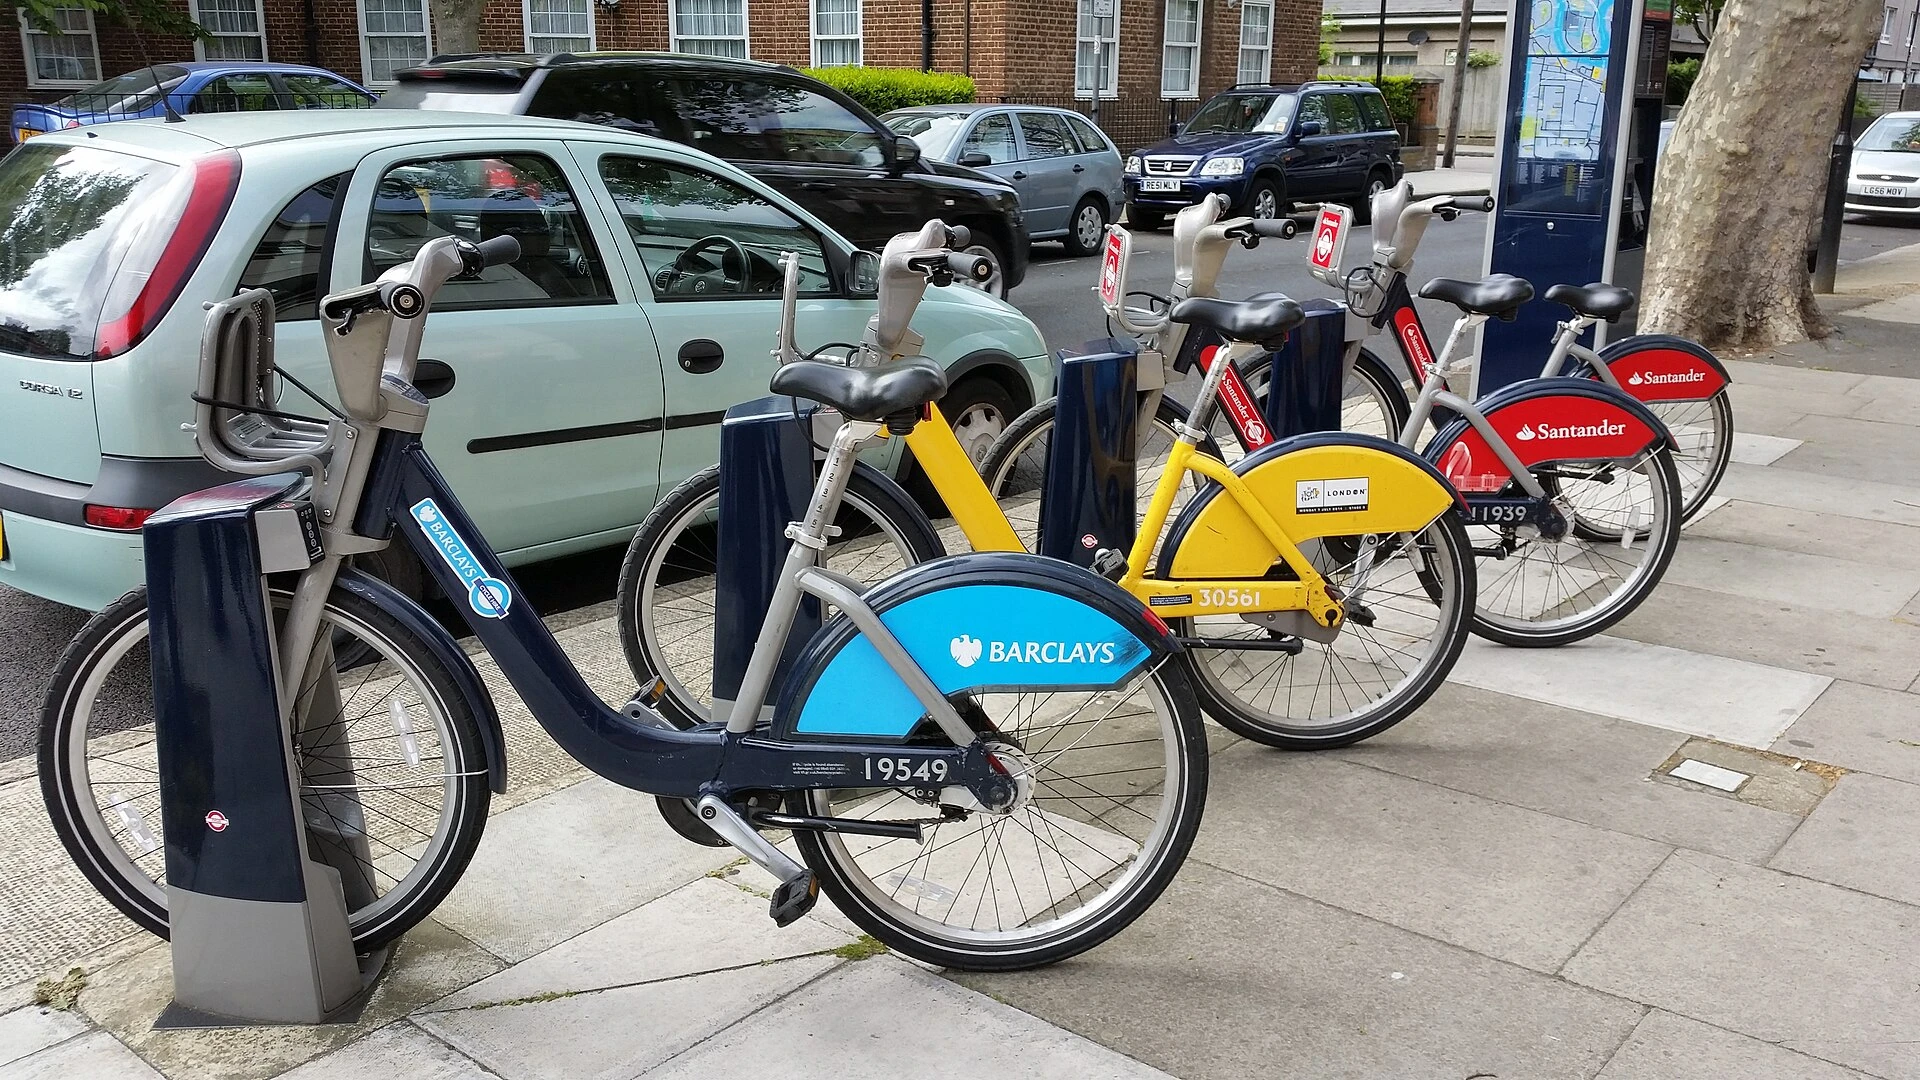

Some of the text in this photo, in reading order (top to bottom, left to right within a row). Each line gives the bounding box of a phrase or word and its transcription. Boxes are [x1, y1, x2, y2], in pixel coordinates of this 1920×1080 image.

[1644, 368, 1706, 385] Santander
[19, 379, 64, 397] CORSA
[1223, 378, 1249, 420] Santander
[1537, 418, 1626, 440] Santander
[1327, 488, 1365, 497] LONDON
[429, 521, 478, 578] BARCLAYS
[1198, 588, 1260, 608] 30561
[988, 641, 1115, 664] BARCLAYS
[864, 757, 948, 782] 19549
